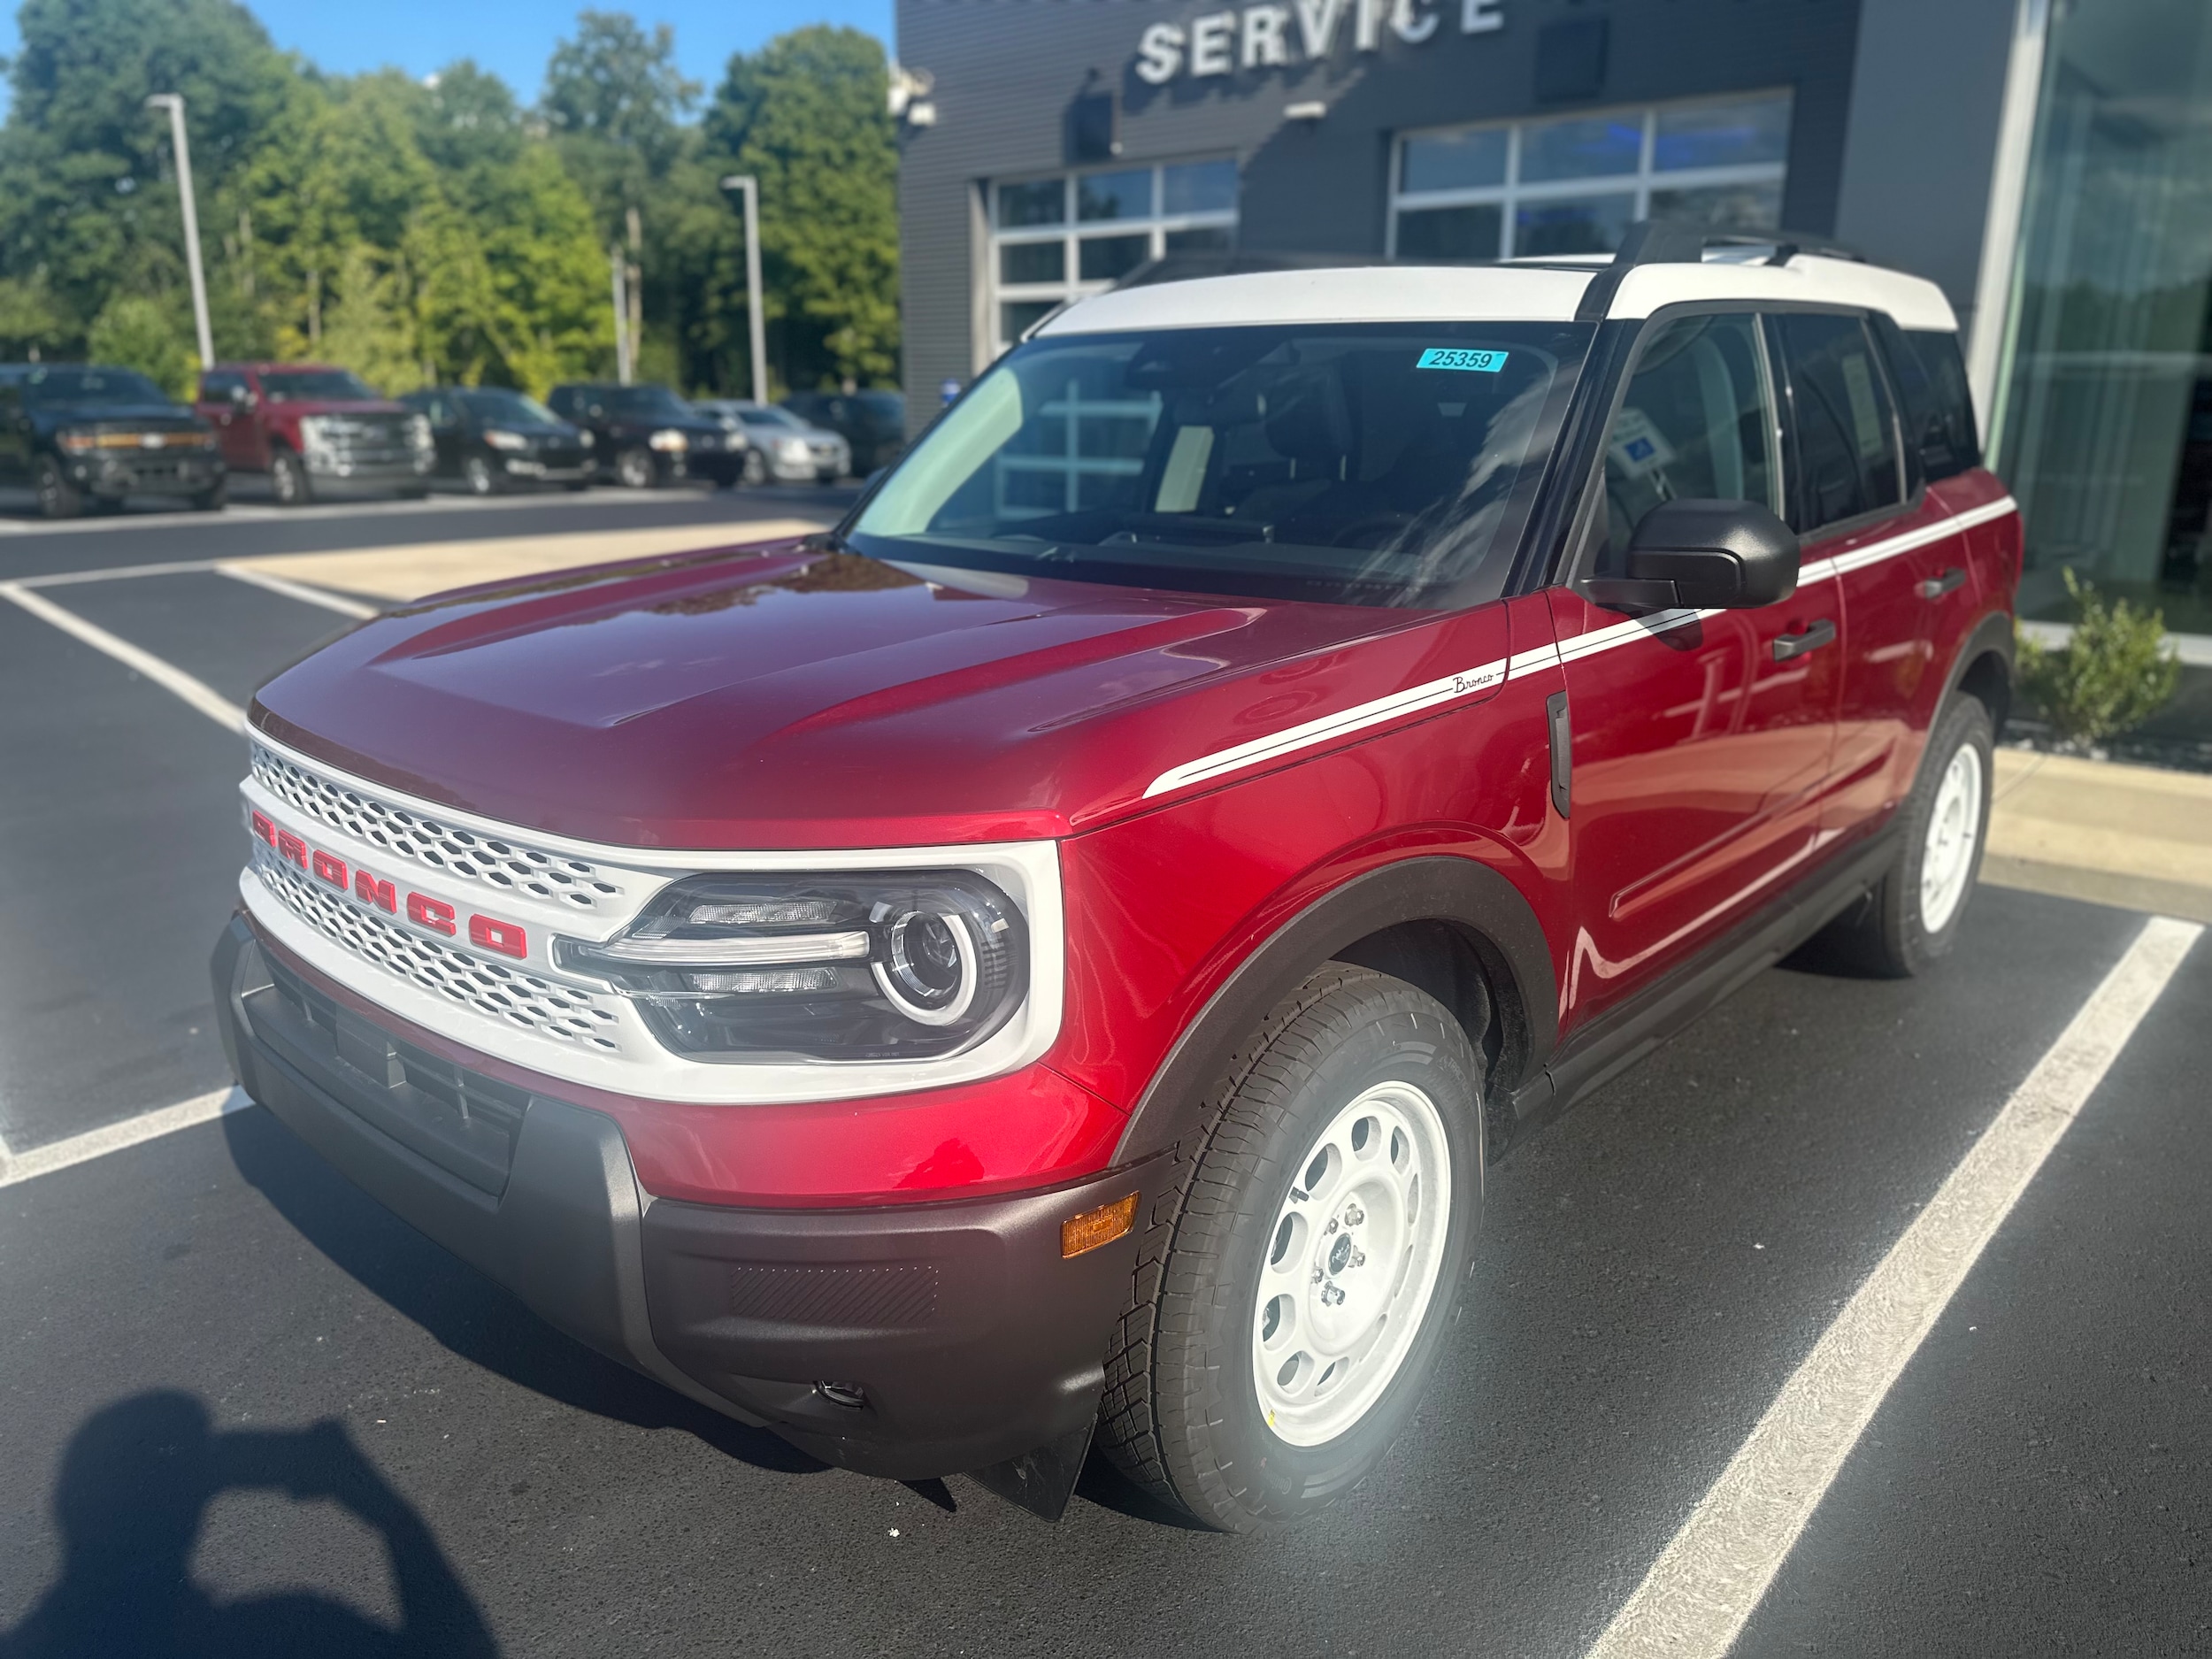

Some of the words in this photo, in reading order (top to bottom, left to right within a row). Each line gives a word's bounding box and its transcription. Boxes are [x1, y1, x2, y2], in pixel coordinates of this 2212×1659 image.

[1135, 0, 1505, 84] SERVICE
[1430, 350, 1493, 368] 25359
[1452, 674, 1494, 694] Bronco
[252, 810, 526, 960] BRONCO
